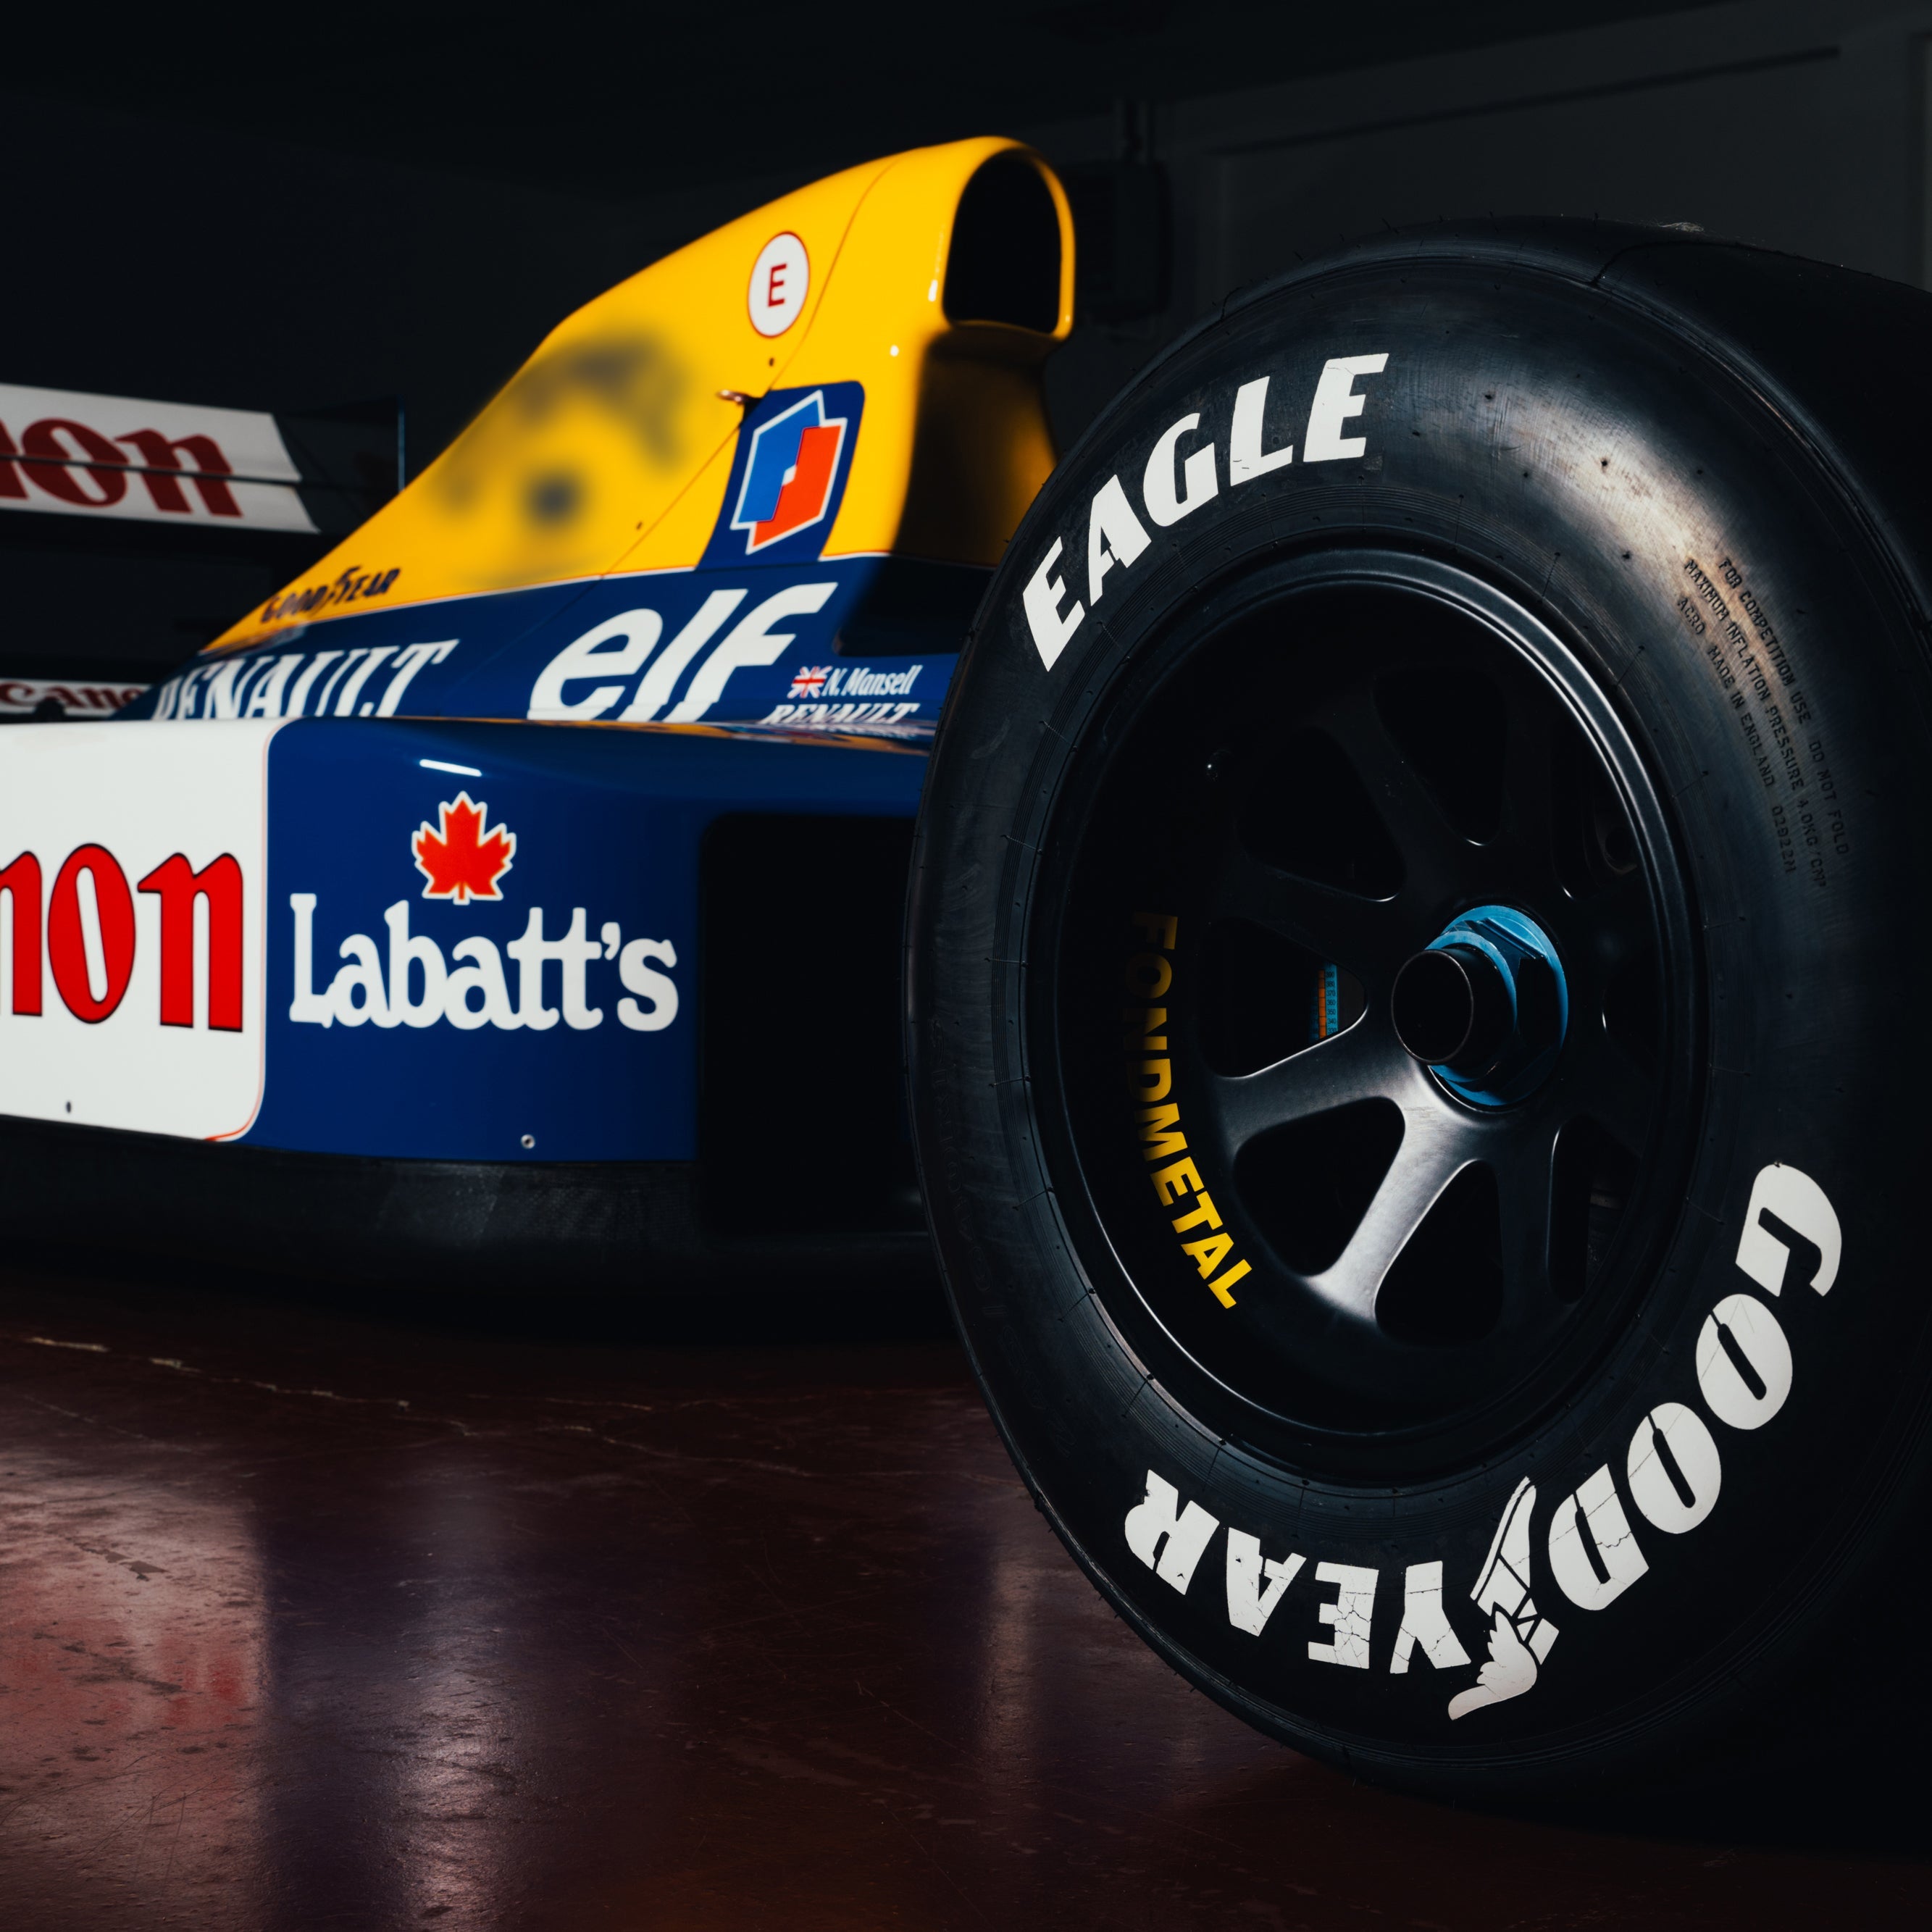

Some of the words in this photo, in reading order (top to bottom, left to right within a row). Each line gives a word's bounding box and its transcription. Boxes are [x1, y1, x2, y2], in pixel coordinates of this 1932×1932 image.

[767, 263, 787, 307] E
[0, 417, 244, 519] on
[1022, 353, 1389, 672] EAGLE
[1719, 558, 1742, 589] FOR
[527, 582, 839, 723] elf
[840, 664, 924, 697] Mansell
[1684, 559, 1730, 622] MAXIMUM
[1726, 622, 1771, 701] INFLATION
[1765, 706, 1805, 791] PRESSURE
[1740, 590, 1796, 686] COMPETITION
[1707, 645, 1736, 689] MADE
[1730, 692, 1745, 710] IN
[1741, 712, 1775, 787] ENGLAND
[1791, 691, 1811, 724] USE
[1810, 740, 1825, 763] DO
[1817, 769, 1837, 800] NOT
[1828, 809, 1849, 855] FOLD
[290, 893, 679, 1032] Labatt's
[1122, 911, 1253, 1310] FONDMETAL
